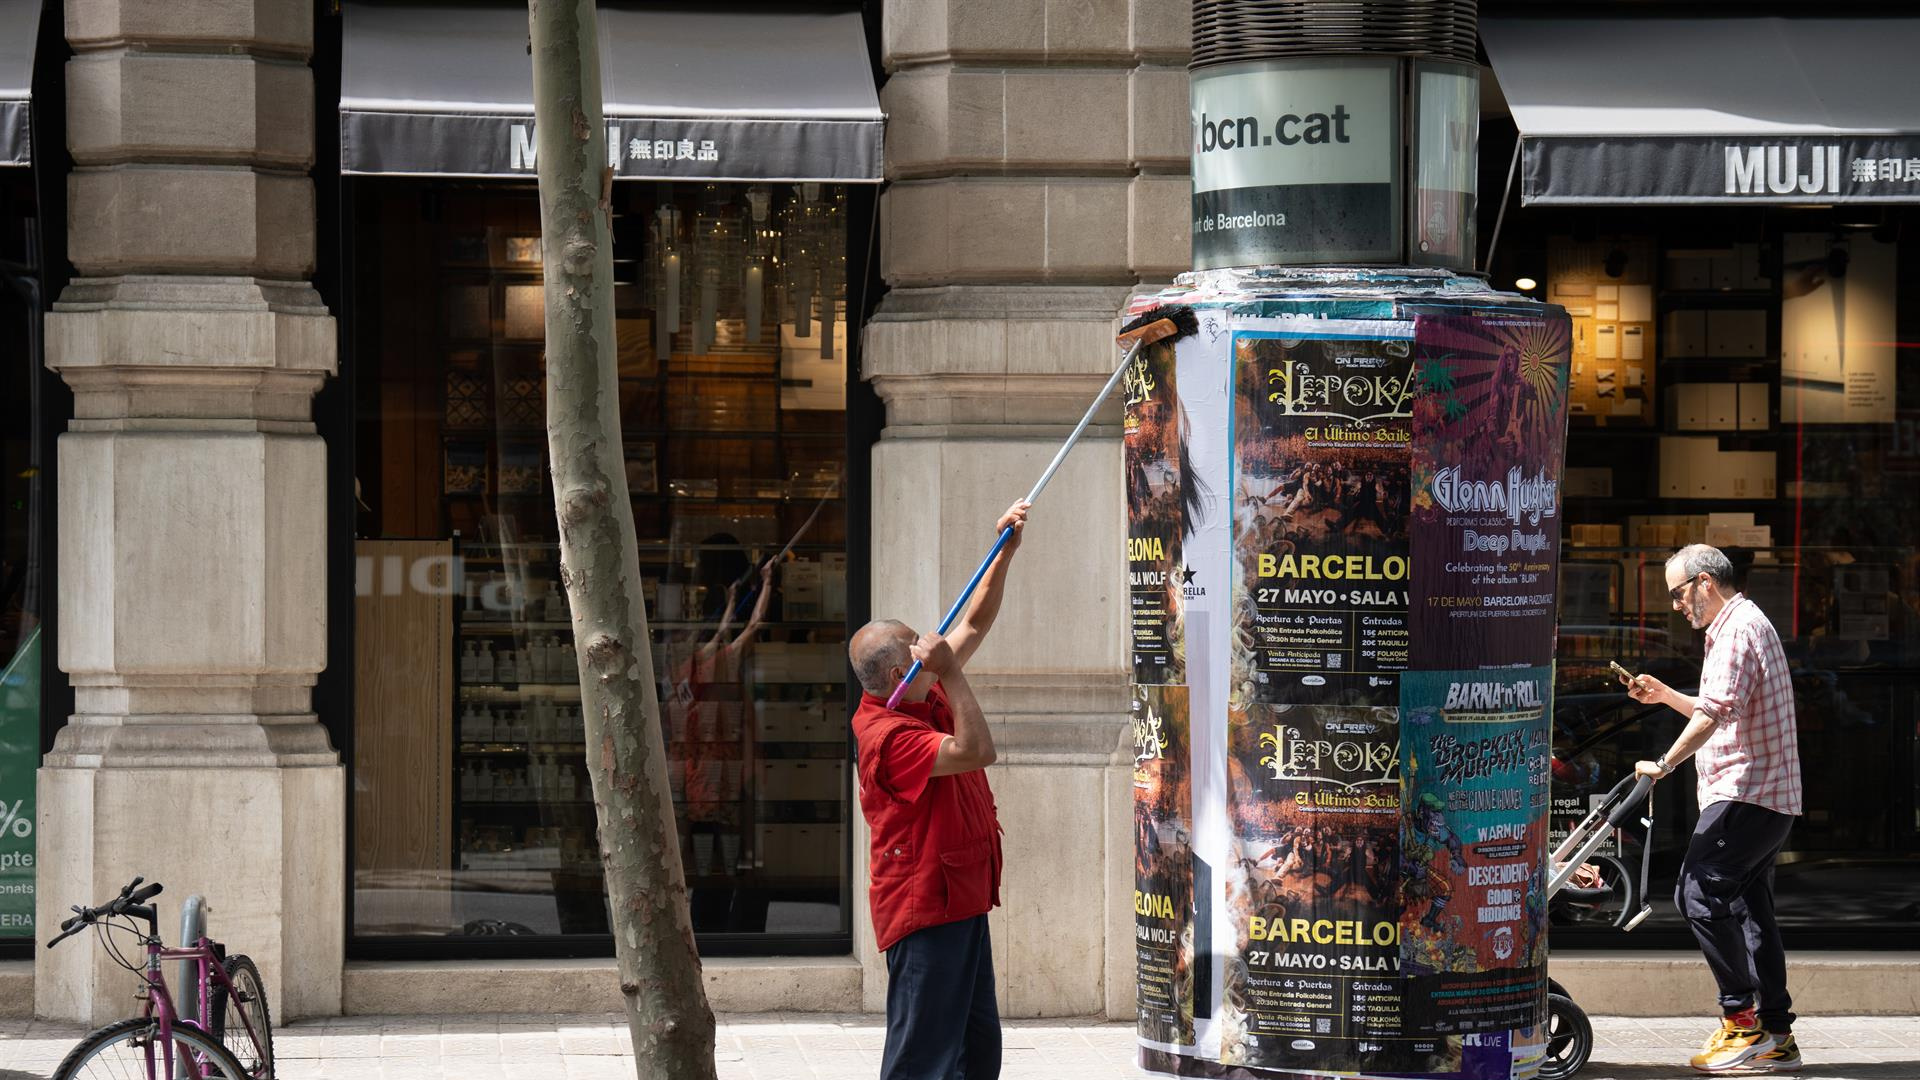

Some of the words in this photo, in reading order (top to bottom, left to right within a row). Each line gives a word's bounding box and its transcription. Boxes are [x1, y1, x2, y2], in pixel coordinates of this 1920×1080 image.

[510, 124, 621, 171] MI
[629, 138, 719, 161] 無印良品
[1724, 145, 1841, 194] MUJI
[1203, 215, 1214, 232] de
[1217, 210, 1286, 230] Barcelona
[1304, 427, 1319, 441] El
[1324, 424, 1370, 441] Último
[1374, 427, 1411, 442] Baile
[1431, 463, 1508, 514] Glenn
[1479, 517, 1508, 526] CLASSIC
[1463, 529, 1510, 557] Deep
[1258, 553, 1410, 580] BARCELO
[1445, 562, 1495, 575] Celebrating
[1496, 562, 1508, 572] the
[1142, 571, 1167, 585] WOLF
[1471, 574, 1480, 585] of
[1483, 574, 1496, 584] the
[1497, 574, 1518, 585] album
[1258, 588, 1280, 603] 27
[1285, 589, 1337, 604] MAYO
[1350, 590, 1398, 605] SALA
[1427, 597, 1439, 607] 17
[1440, 596, 1455, 607] DE
[1456, 596, 1482, 607] MAYO
[1483, 596, 1528, 607] BARCELONA
[1256, 615, 1292, 625] Apertura
[1294, 615, 1304, 624] de
[1308, 616, 1343, 626] Puertas
[1362, 616, 1403, 626] Entradas
[1479, 610, 1488, 618] DE
[1487, 610, 1510, 618] PUERTAS
[1279, 627, 1304, 635] Entrada
[1290, 636, 1316, 644] Entrada
[1295, 791, 1309, 805] El
[1314, 789, 1361, 806] Último
[1364, 795, 1400, 808] Baile
[1554, 797, 1580, 808] regal
[1565, 808, 1586, 816] botiga
[1477, 822, 1511, 842] WARM
[1512, 823, 1527, 841] UP
[1468, 862, 1530, 887] DESCENDENTS
[1486, 888, 1512, 905] GOOD
[1477, 903, 1521, 923] RIDDANCE
[1150, 928, 1177, 944] WOLF
[1249, 916, 1400, 946] BARCELO
[1249, 951, 1270, 966] 27
[1274, 952, 1327, 969] MAYO
[1339, 955, 1388, 971] SALA
[1284, 979, 1294, 988] de
[1298, 980, 1333, 990] Puertas
[1352, 981, 1393, 991] Entradas
[1269, 990, 1295, 998] Entrada
[1295, 992, 1333, 1000] Folkohólica
[1353, 994, 1366, 1002] 15€
[1279, 1000, 1306, 1009] Entrada
[1483, 1036, 1503, 1048] LIVE
